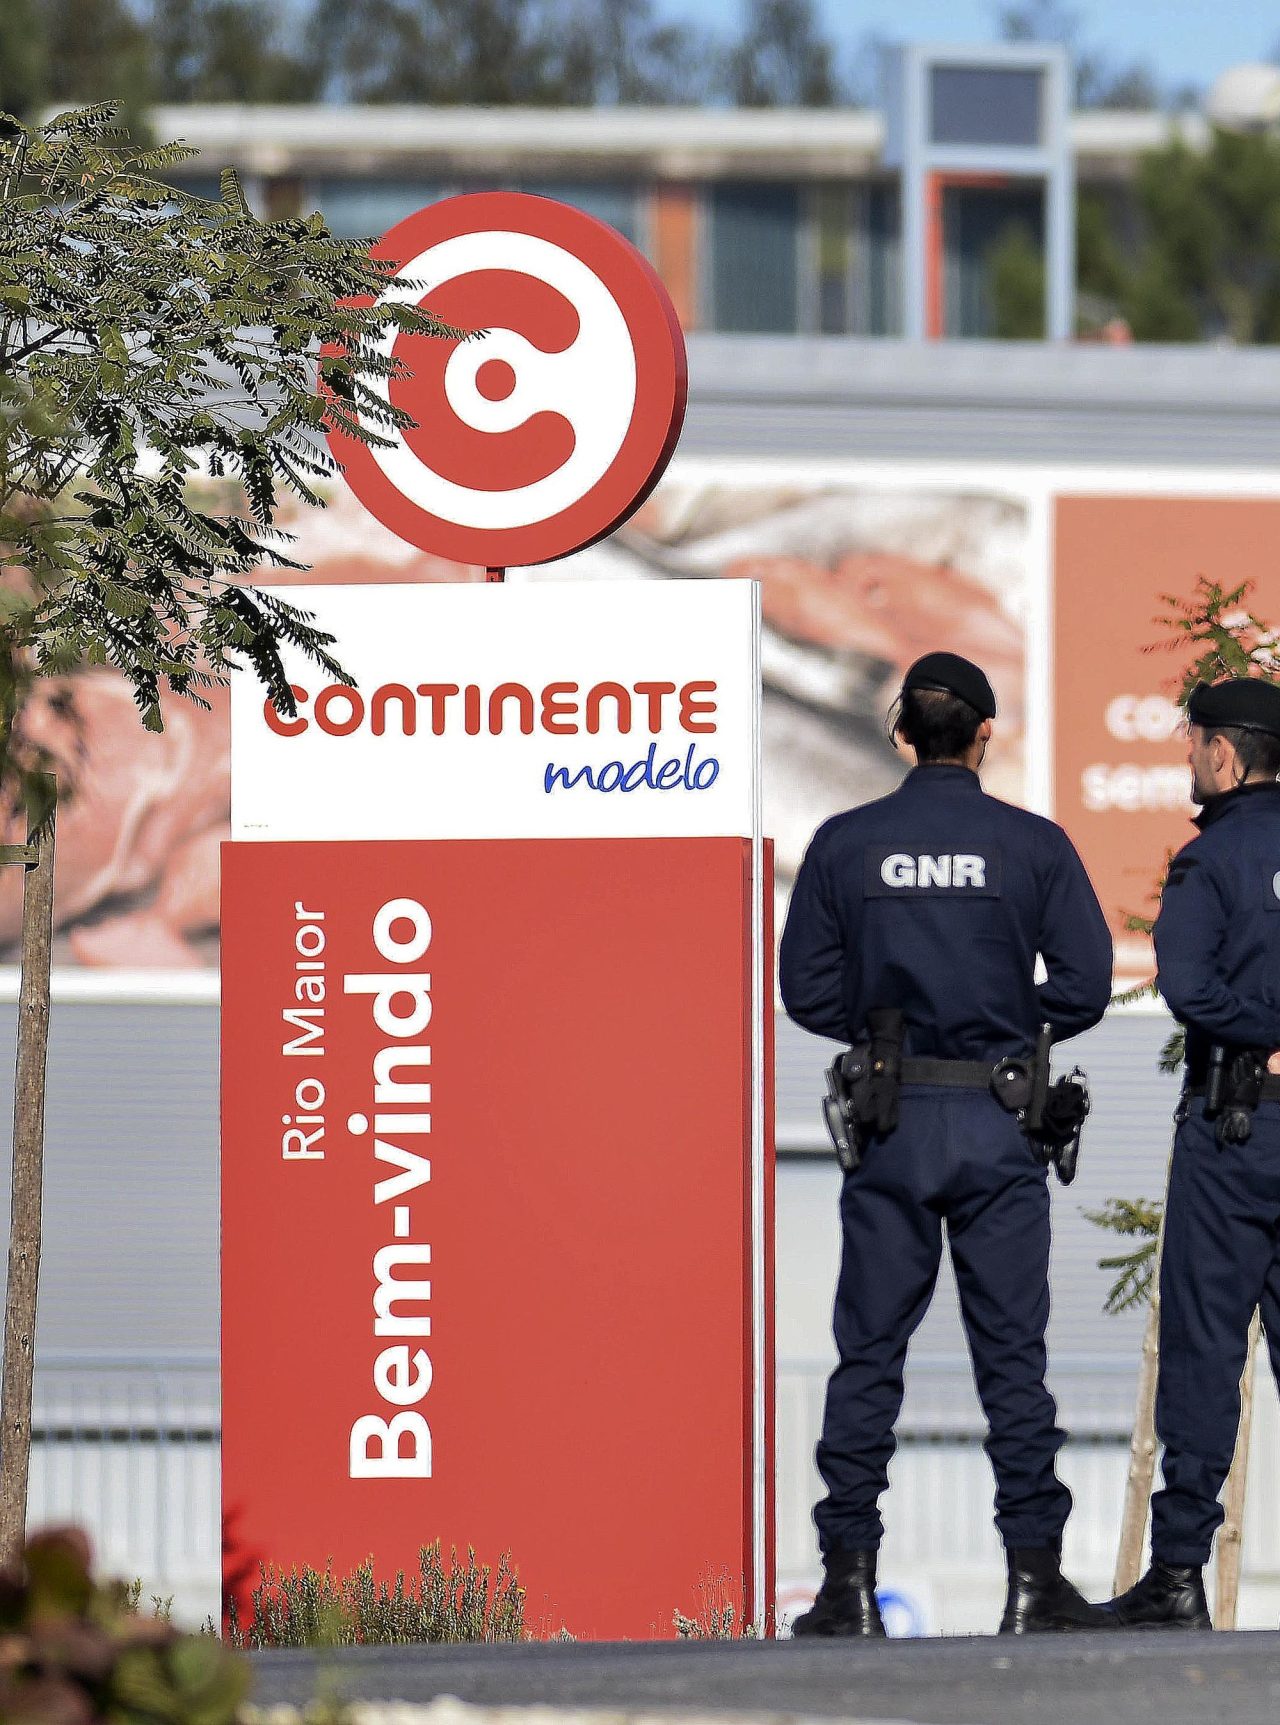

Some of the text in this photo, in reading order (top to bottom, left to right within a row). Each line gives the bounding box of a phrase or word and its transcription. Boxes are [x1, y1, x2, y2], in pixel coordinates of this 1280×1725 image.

[263, 680, 718, 738] CONTINENTE
[544, 741, 720, 794] modelo
[880, 853, 987, 889] GNR
[281, 900, 326, 1160] Rio Maior
[342, 896, 434, 1480] Bem-vindo
